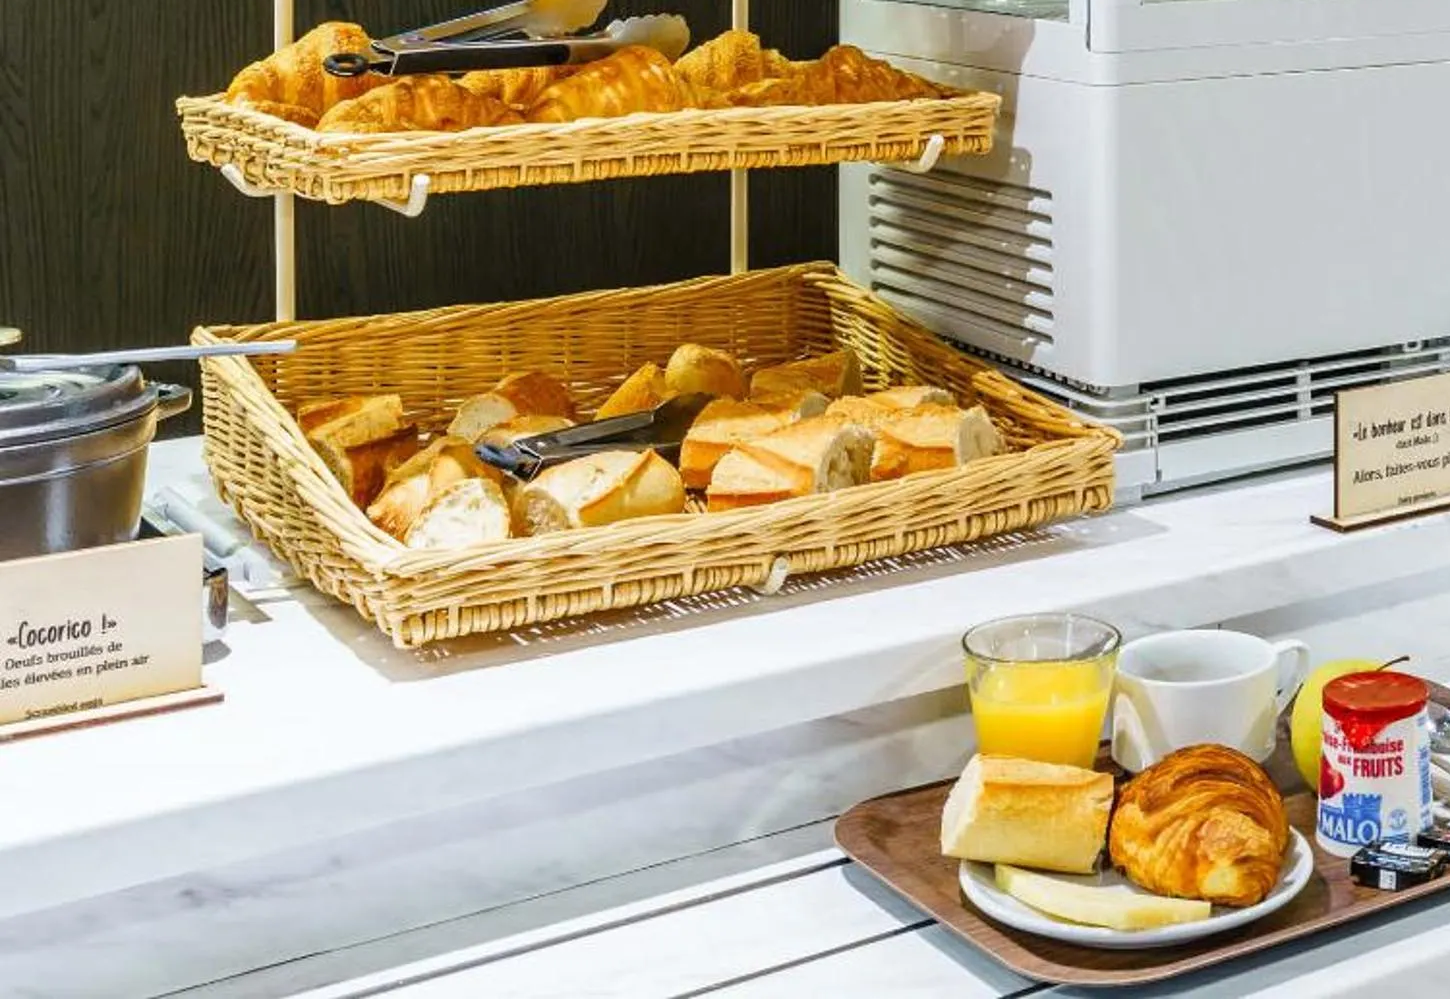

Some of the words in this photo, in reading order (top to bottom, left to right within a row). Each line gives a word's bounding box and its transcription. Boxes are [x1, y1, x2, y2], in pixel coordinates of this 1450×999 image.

[1371, 418, 1406, 440] bonheur
[1427, 410, 1446, 428] dans
[46, 645, 104, 663] brouillés
[107, 641, 123, 653] de
[24, 665, 73, 686] élevées
[77, 665, 93, 677] en
[96, 658, 129, 676] plein
[131, 655, 150, 667] air
[1352, 756, 1404, 778] FRUITS
[1321, 808, 1380, 845] MALO
